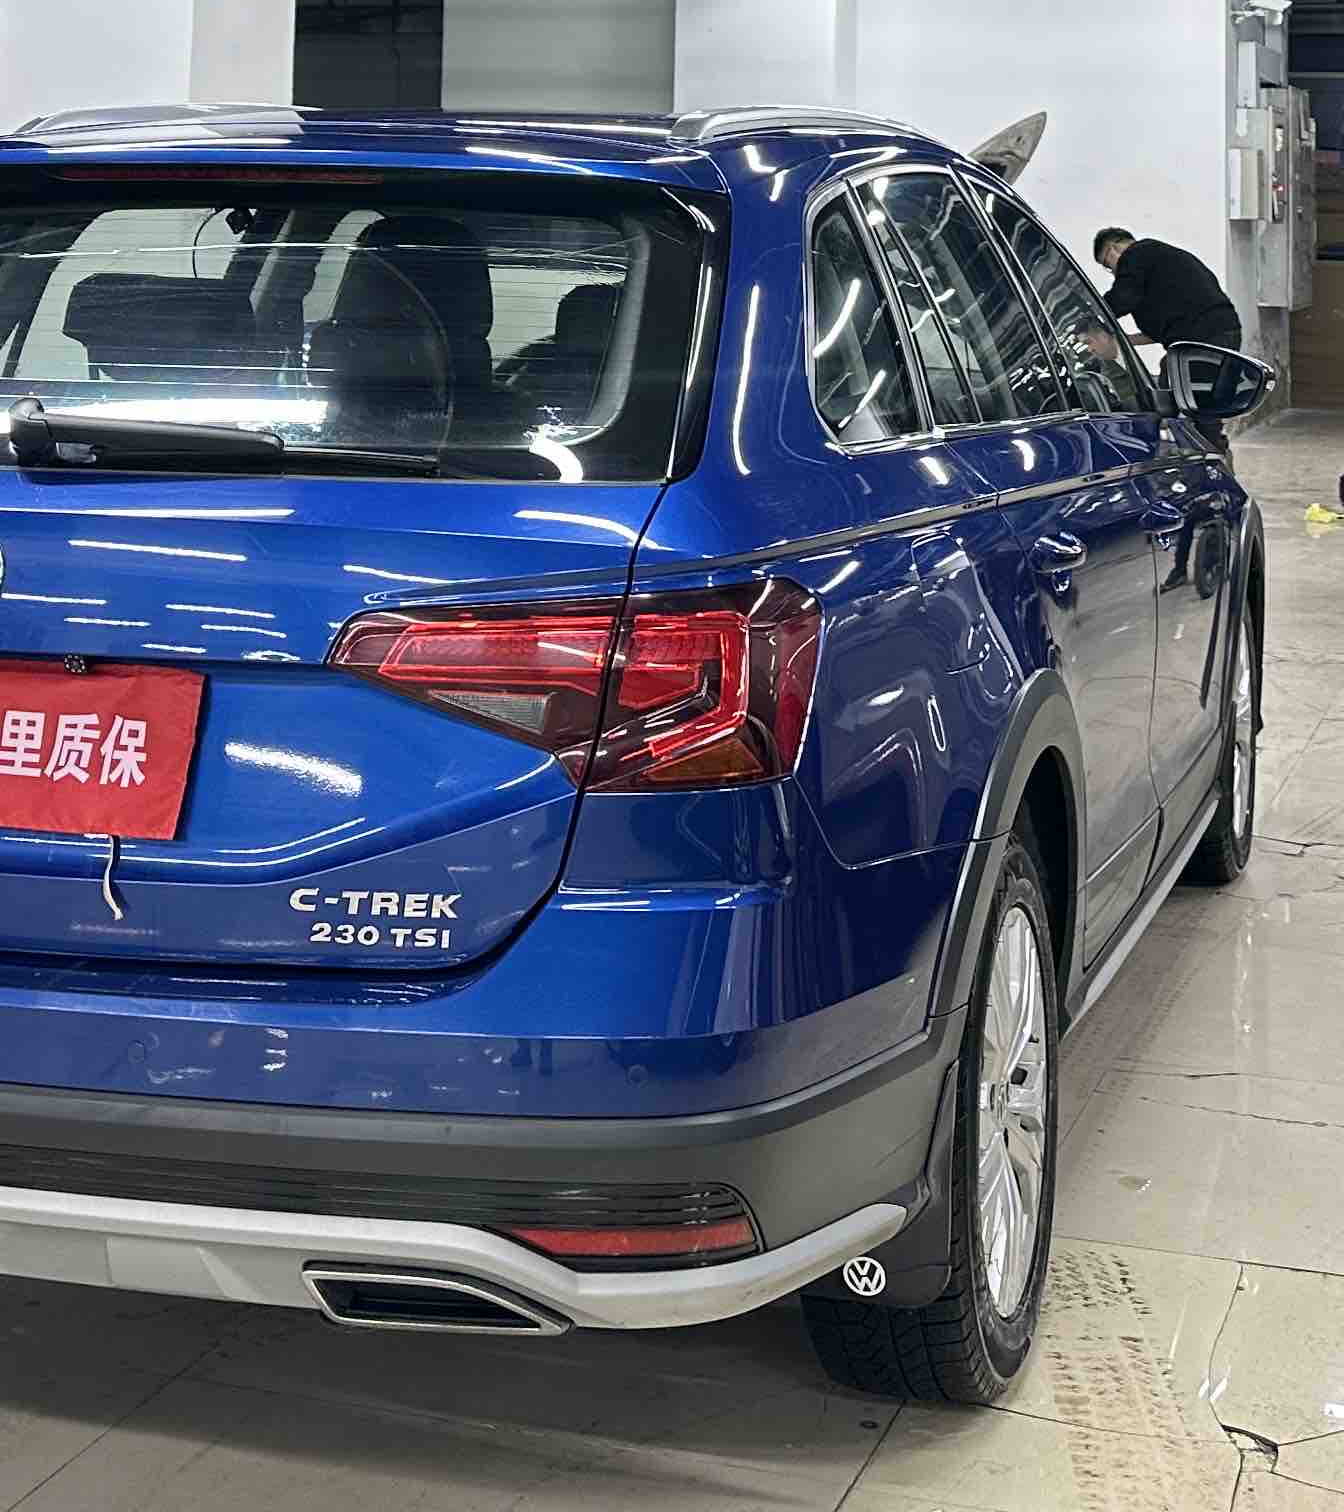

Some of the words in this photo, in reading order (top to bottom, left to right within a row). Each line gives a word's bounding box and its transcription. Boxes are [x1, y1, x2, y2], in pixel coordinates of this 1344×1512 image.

[289, 887, 462, 919] C-TREK
[310, 922, 380, 946] 230
[390, 928, 451, 949] TSI
